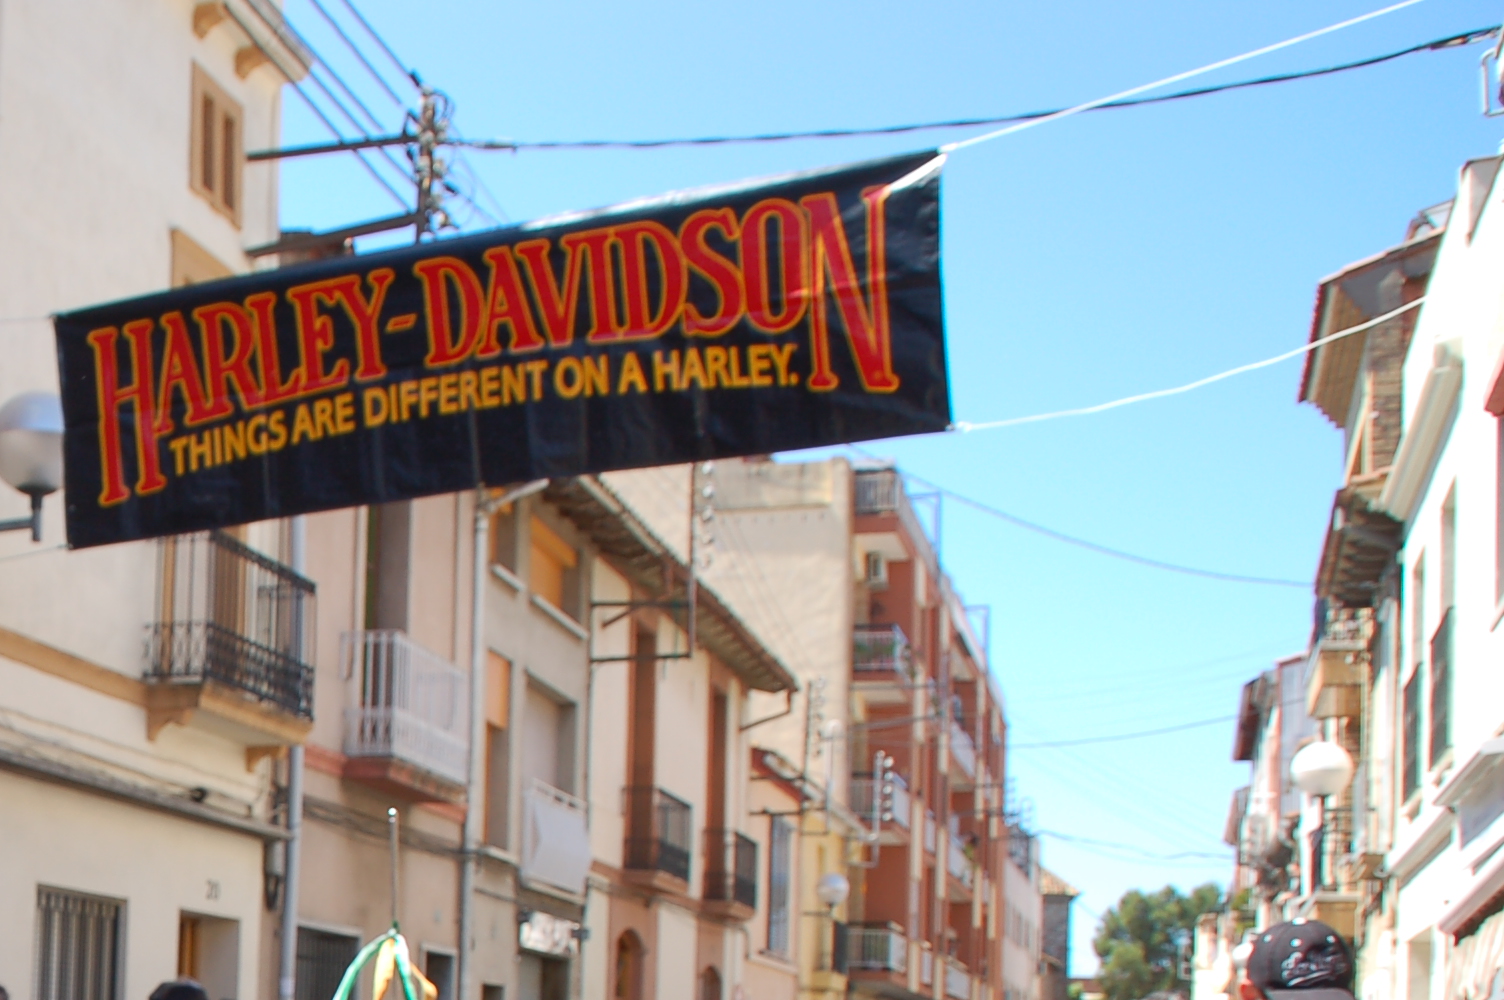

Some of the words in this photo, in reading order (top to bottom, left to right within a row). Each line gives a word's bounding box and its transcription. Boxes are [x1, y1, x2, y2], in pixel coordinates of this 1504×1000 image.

[87, 184, 899, 506] HARLEY-DAVIDSON
[169, 409, 287, 476] THINGS
[291, 393, 355, 445] ARE
[362, 359, 549, 428] DIFFERENT
[553, 353, 610, 399] ON
[618, 351, 648, 394] A
[652, 343, 800, 392] HARLEY.
